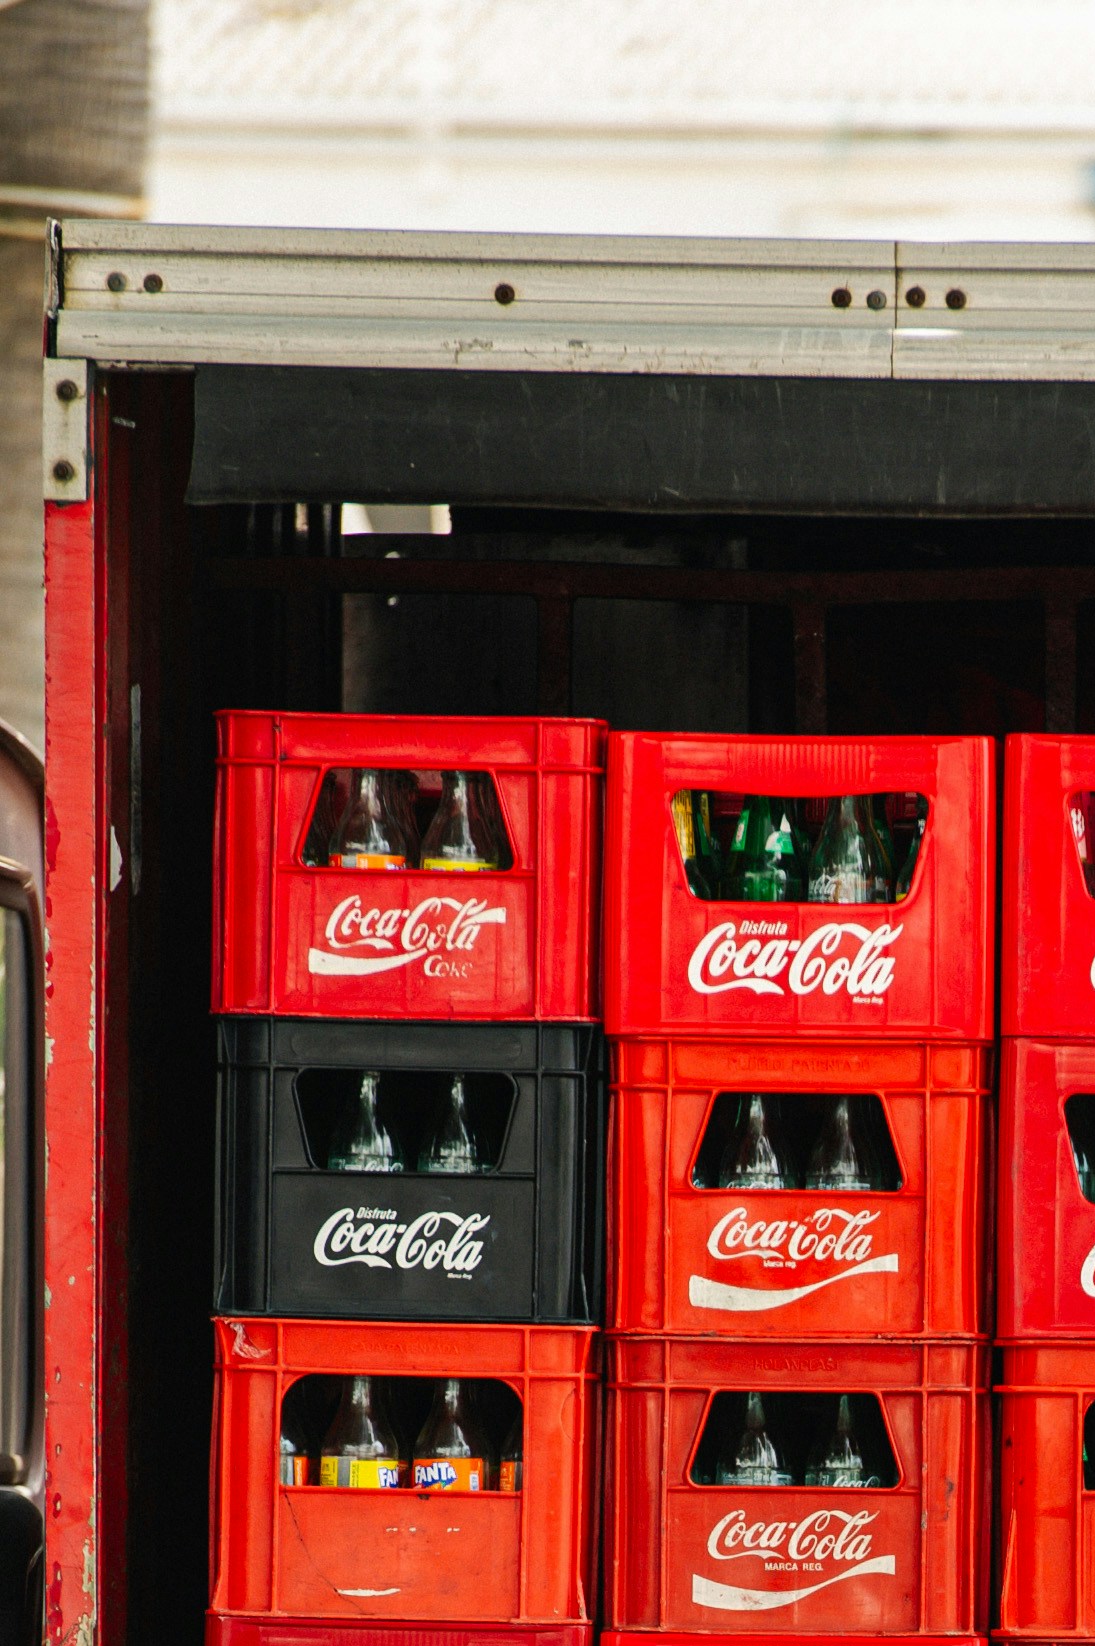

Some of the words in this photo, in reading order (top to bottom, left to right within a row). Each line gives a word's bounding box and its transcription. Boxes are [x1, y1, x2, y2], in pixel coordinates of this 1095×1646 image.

[325, 895, 489, 952] Coca-Cola
[739, 920, 787, 935] Disfruta
[688, 922, 903, 996] Coca-Cola
[314, 1207, 490, 1270] Coca-Cola
[357, 1207, 396, 1220] Disfruta
[707, 1207, 880, 1262] Coca-Cola
[414, 1460, 458, 1484] FANTA
[707, 1509, 881, 1560] Coca-Cola
[764, 1562, 798, 1571] MARCA
